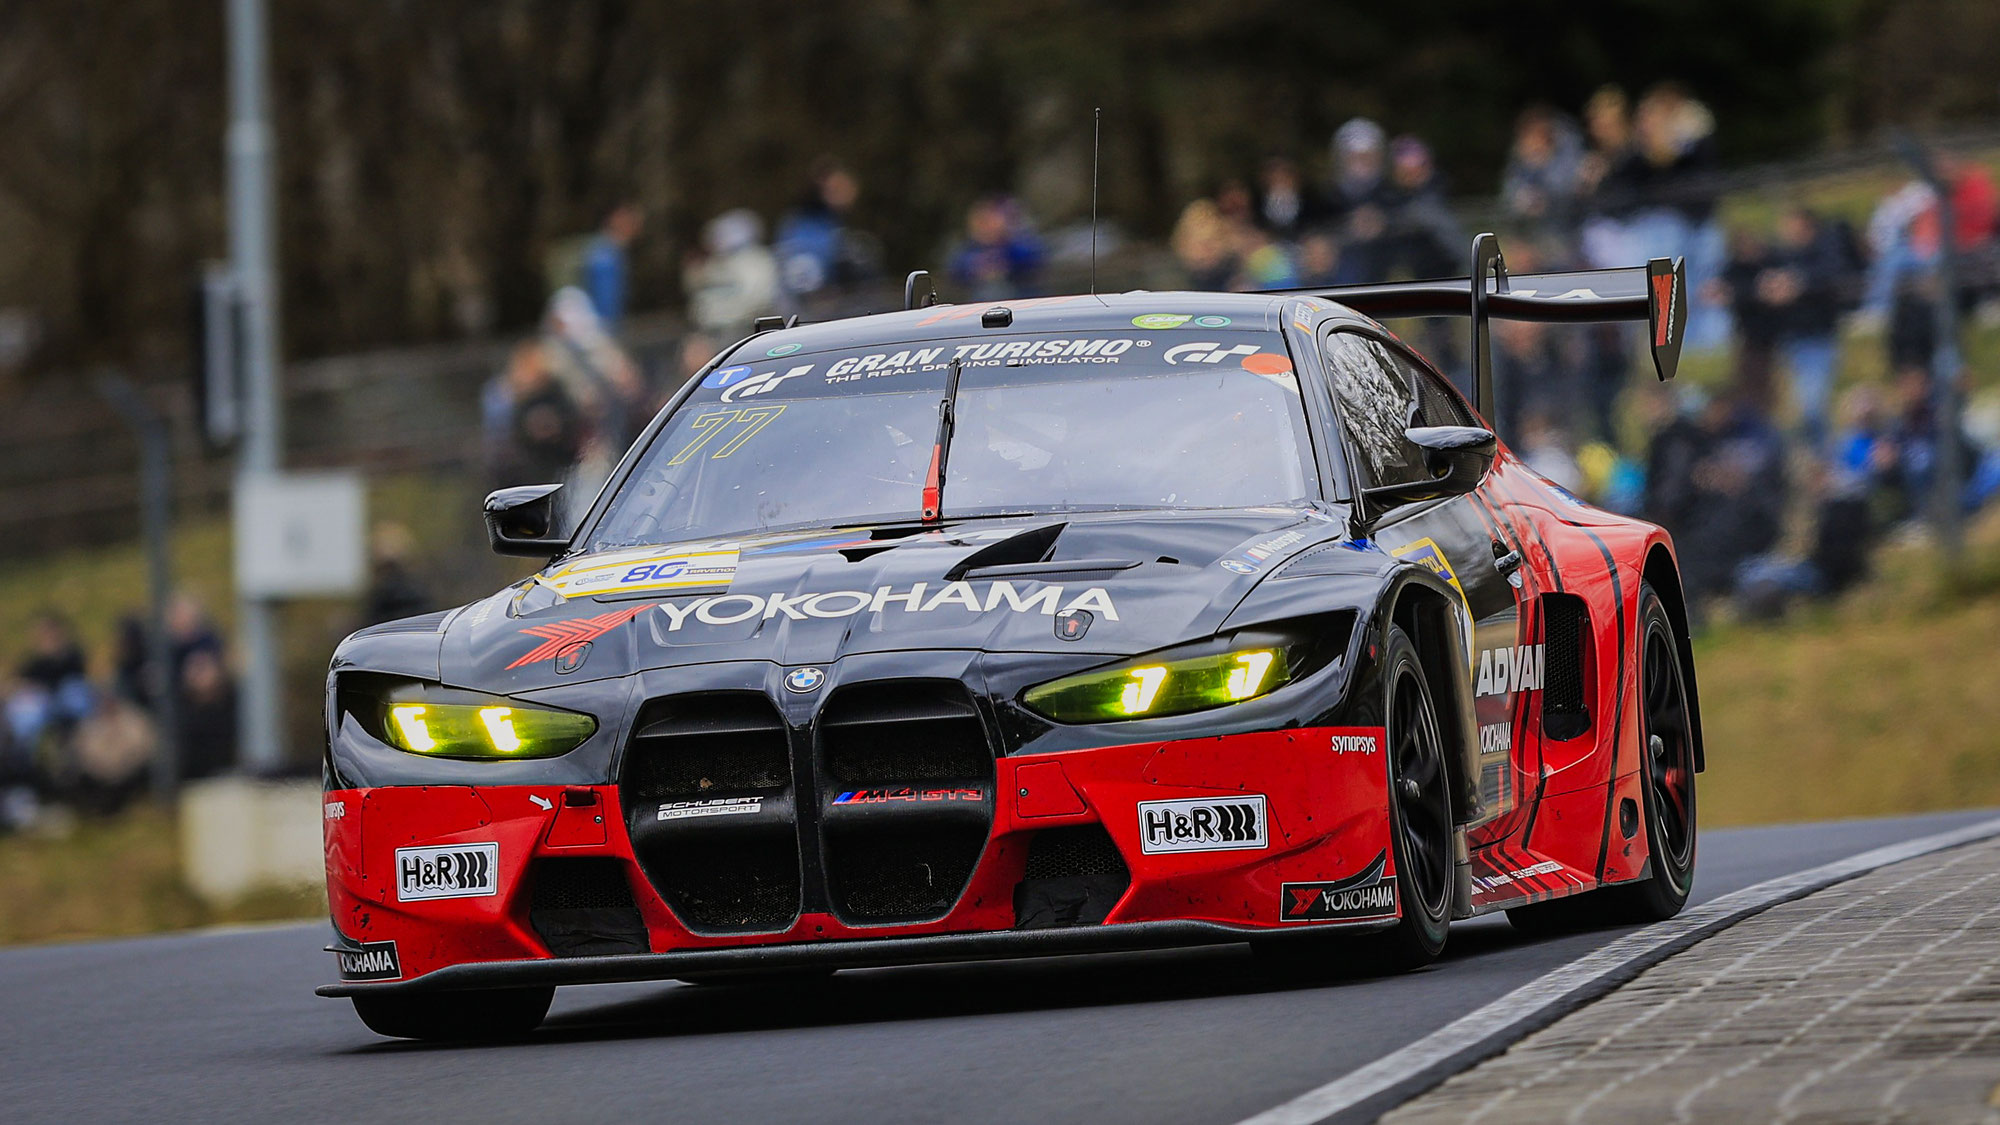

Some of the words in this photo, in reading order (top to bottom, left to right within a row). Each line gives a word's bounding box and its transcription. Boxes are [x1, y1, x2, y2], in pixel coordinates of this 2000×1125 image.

[825, 347, 945, 377] GRAN
[825, 373, 861, 385] THE
[867, 367, 917, 379] REAL
[922, 359, 1000, 372] DRVING
[1006, 356, 1120, 366] SIMULATOR
[718, 368, 745, 385] T
[667, 405, 788, 466] 77
[620, 561, 688, 583] 80
[689, 567, 736, 575] RAVENOL
[658, 581, 1120, 631] YOKOHAMA
[1476, 643, 1545, 698] ADVAN
[1331, 735, 1376, 756] SYNOPSYS
[659, 796, 764, 810] SCHUBERT
[921, 788, 984, 801] GT3
[662, 805, 756, 818] MOTORSPORT
[1146, 807, 1219, 845] H&R
[402, 855, 457, 892] H&R
[1322, 885, 1394, 911] YOKOHAMA
